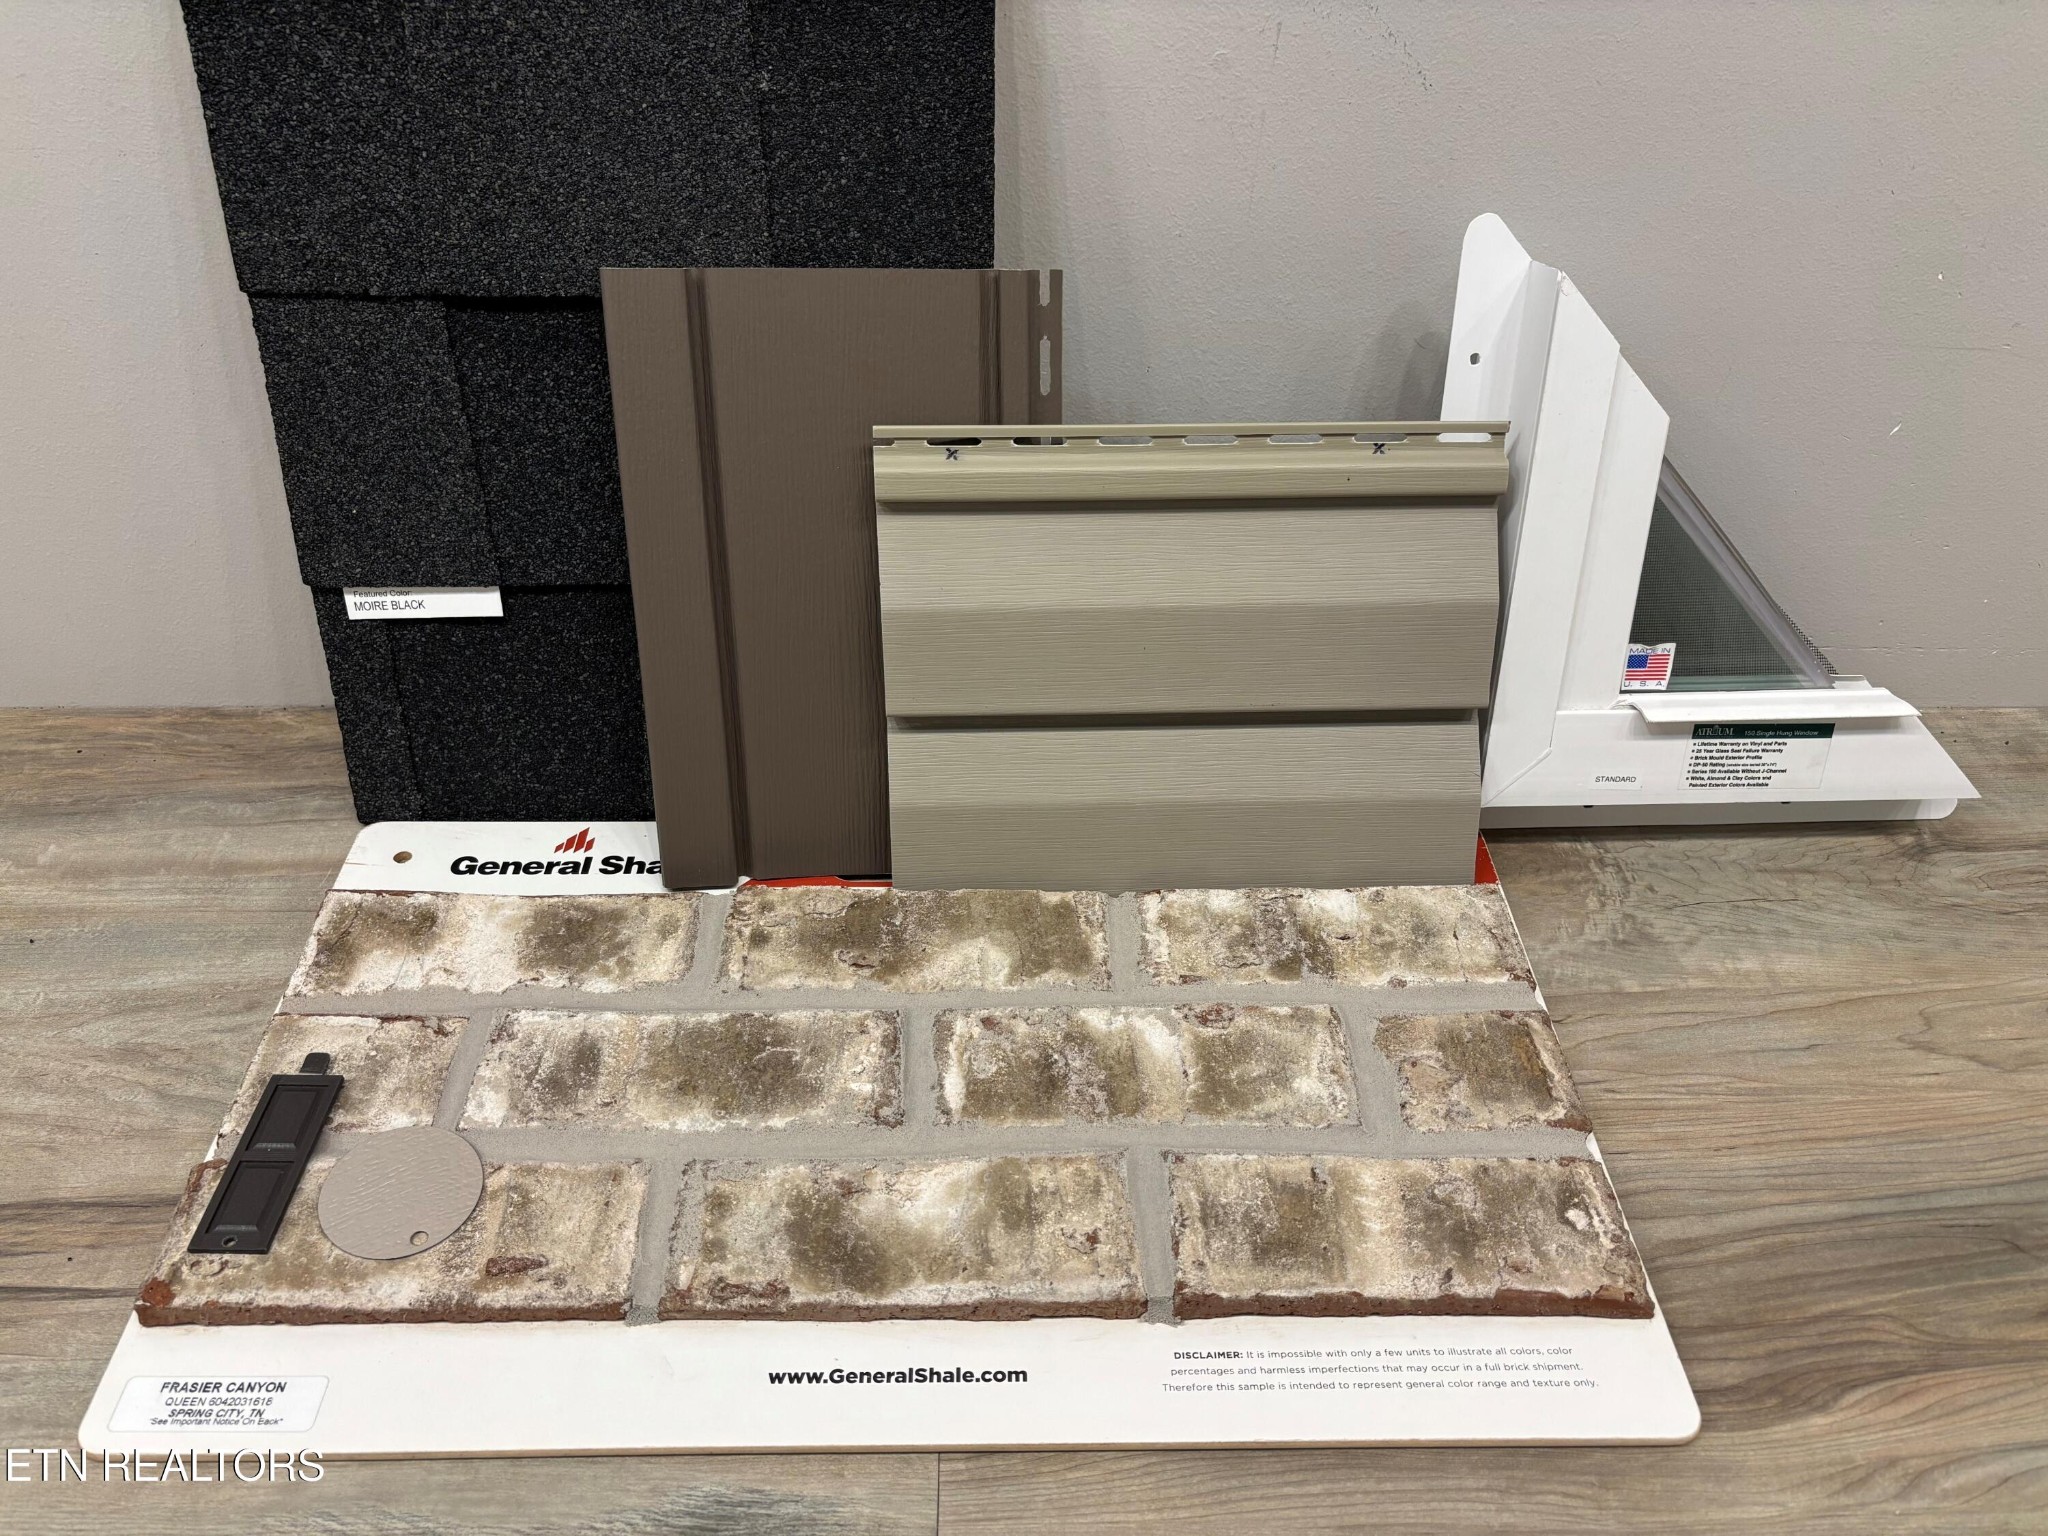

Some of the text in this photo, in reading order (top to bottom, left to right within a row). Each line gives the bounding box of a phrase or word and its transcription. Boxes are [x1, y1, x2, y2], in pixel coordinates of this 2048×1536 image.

[353, 589, 412, 598] Featured Color:
[354, 600, 426, 611] MOIRE BLACK
[1655, 680, 1665, 688] A.
[450, 854, 662, 876] General Sha
[1174, 1351, 1244, 1360] DISCLAIMER:
[1246, 1351, 1254, 1359] It
[1257, 1350, 1265, 1359] is
[1268, 1350, 1323, 1360] impossible
[1325, 1349, 1348, 1358] with
[1350, 1349, 1372, 1360] only
[1384, 1349, 1403, 1357] few
[1406, 1348, 1431, 1357] units
[1434, 1349, 1445, 1357] to
[1447, 1347, 1493, 1356] illustrate
[1495, 1347, 1507, 1356] all
[1509, 1347, 1545, 1356] colors,
[1546, 1347, 1573, 1355] color
[768, 1367, 1028, 1384] www.GeneralShale.com
[1171, 1367, 1235, 1377] percentages
[1238, 1366, 1257, 1375] and
[1259, 1366, 1306, 1375] harmless
[1308, 1365, 1380, 1375] imperfections
[1382, 1364, 1403, 1373] that
[1406, 1366, 1428, 1374] may
[1464, 1364, 1473, 1372] in
[1484, 1363, 1501, 1372] full
[1503, 1363, 1530, 1372] brick
[1532, 1362, 1584, 1373] shipment.
[160, 1382, 288, 1394] FRASIER CANYON
[1162, 1378, 1599, 1392] Therefore this sample is intended to represent general color range and texture only.
[165, 1397, 206, 1407] QUEEN
[168, 1408, 266, 1420] SPRING CITY, TN
[170, 1418, 211, 1427] Important
[214, 1418, 240, 1426] Notice
[242, 1418, 256, 1426] On
